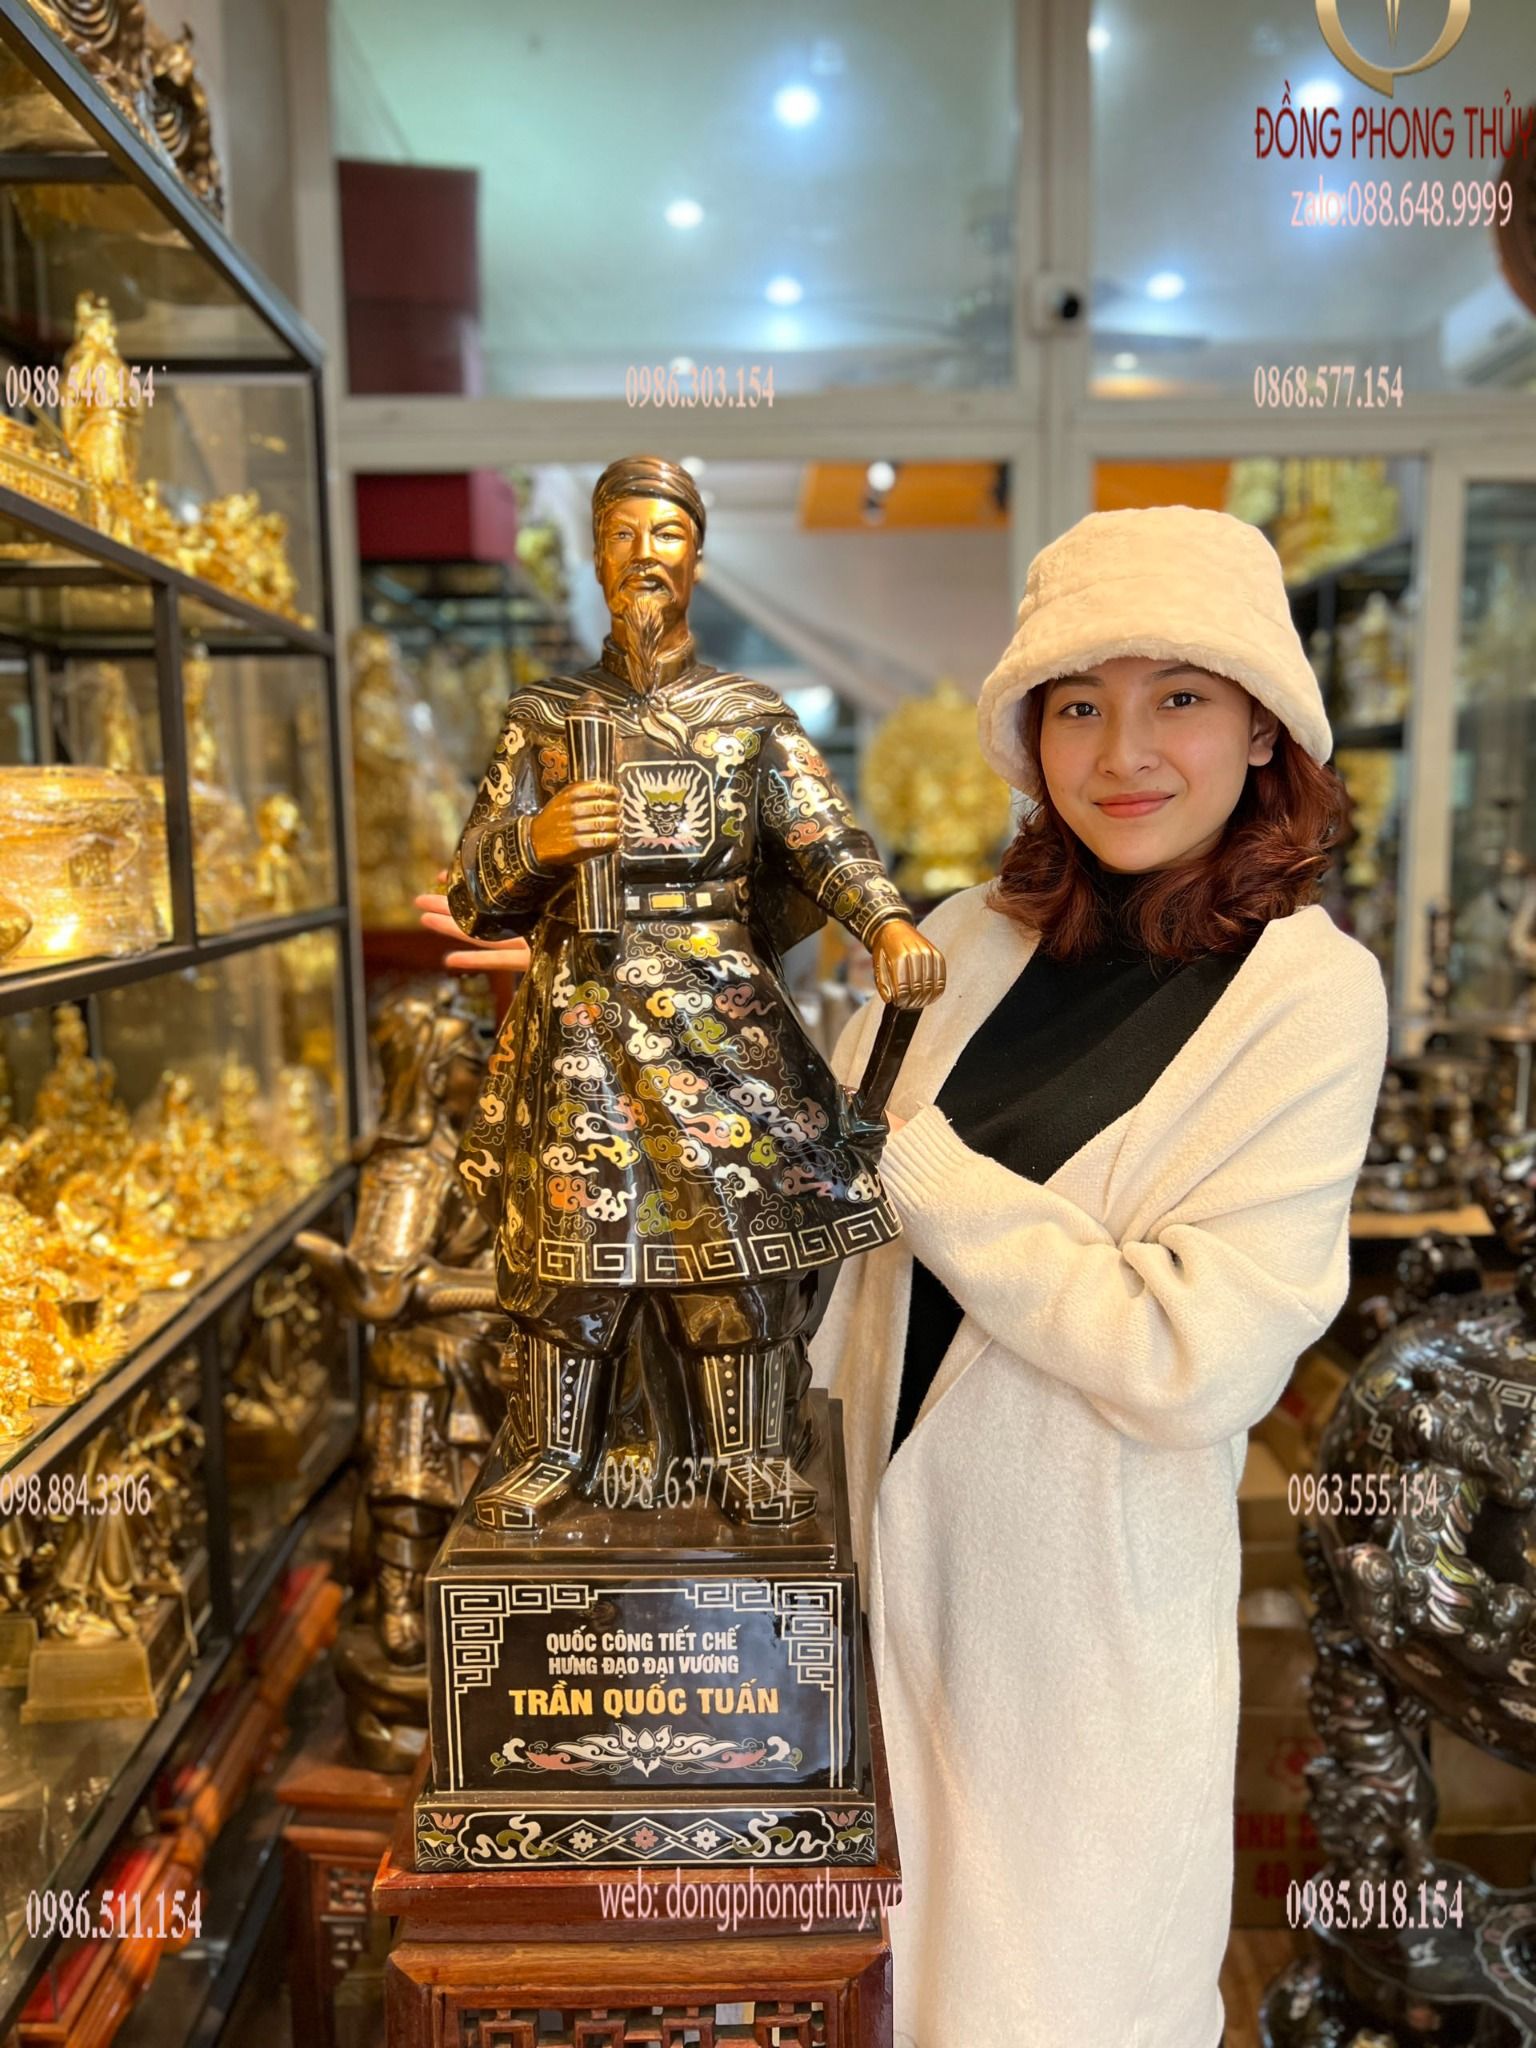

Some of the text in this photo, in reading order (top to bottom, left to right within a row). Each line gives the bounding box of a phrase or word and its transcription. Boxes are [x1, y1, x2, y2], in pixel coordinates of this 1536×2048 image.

[546, 1624, 741, 1655] QUỐC CÔNG TIẾT CHẾ
[548, 1653, 739, 1678] HƯNG ĐẠO ĐẠI VƯƠNG
[508, 1678, 779, 1719] TRẦN QUỐC TUẤN
